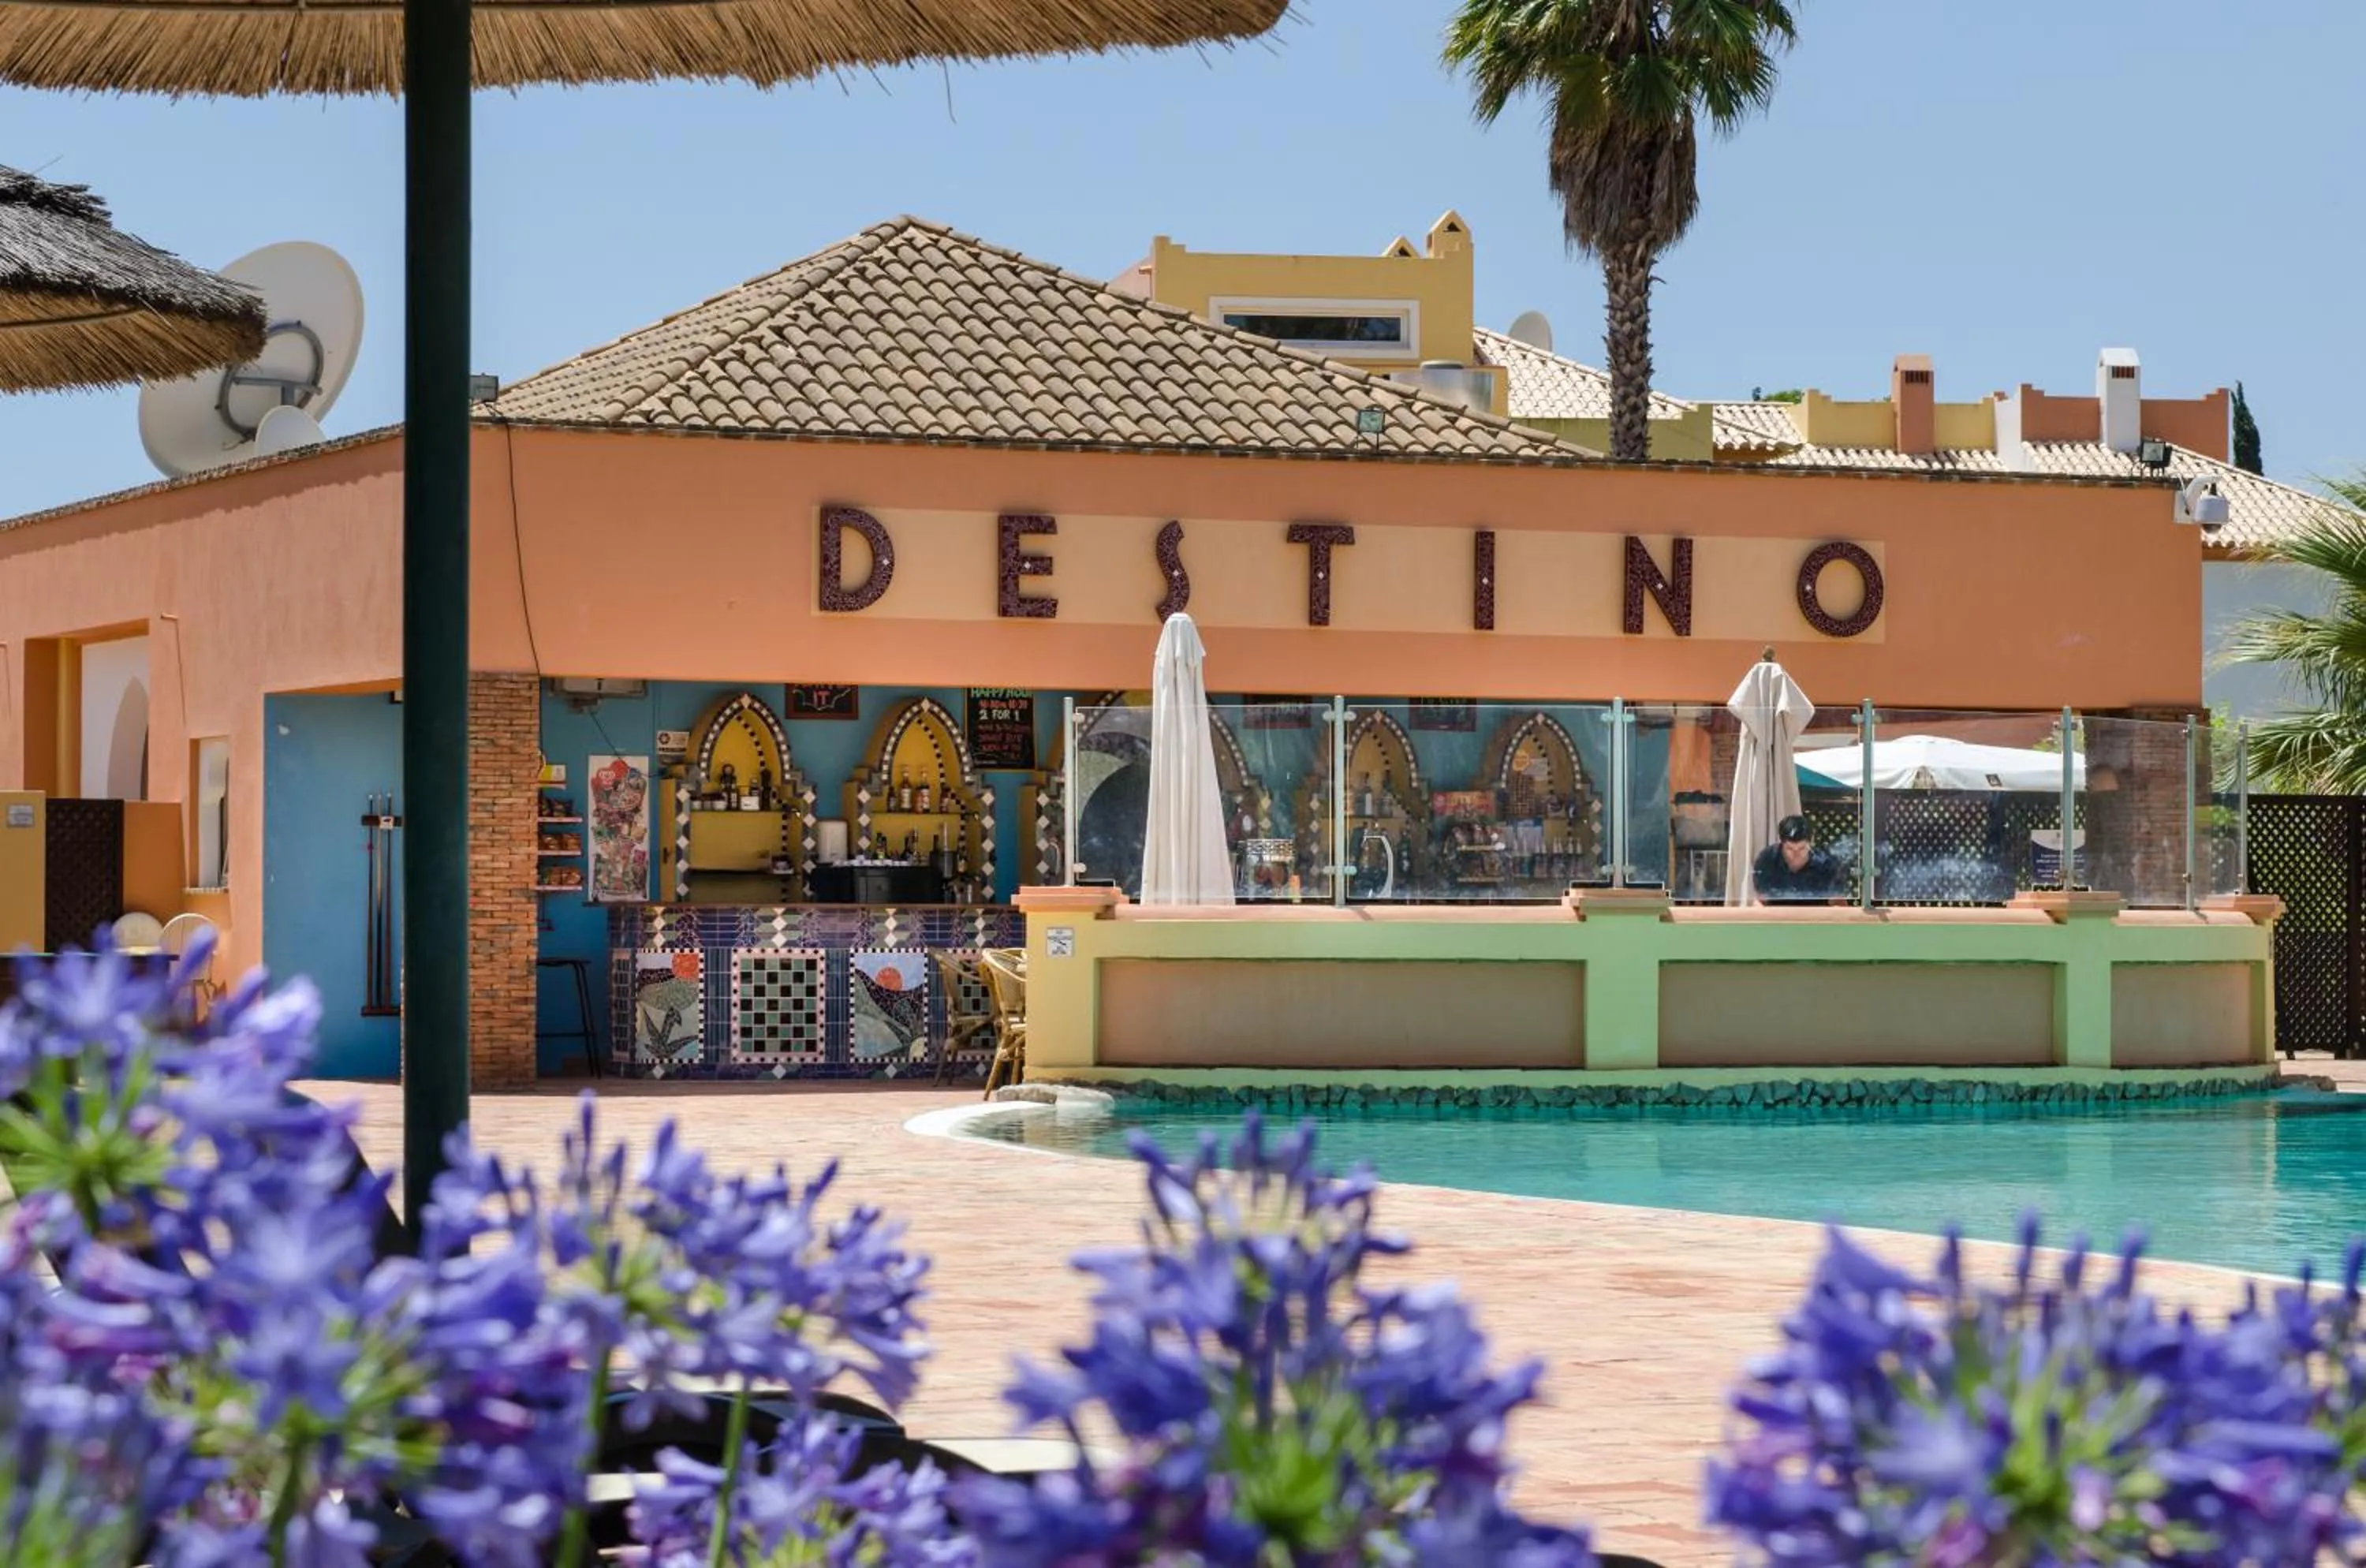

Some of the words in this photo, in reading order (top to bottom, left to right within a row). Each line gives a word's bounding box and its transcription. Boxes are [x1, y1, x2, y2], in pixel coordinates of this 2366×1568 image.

[819, 505, 1885, 637] DESTINO
[979, 709, 989, 720] 2
[991, 709, 1010, 720] FOR
